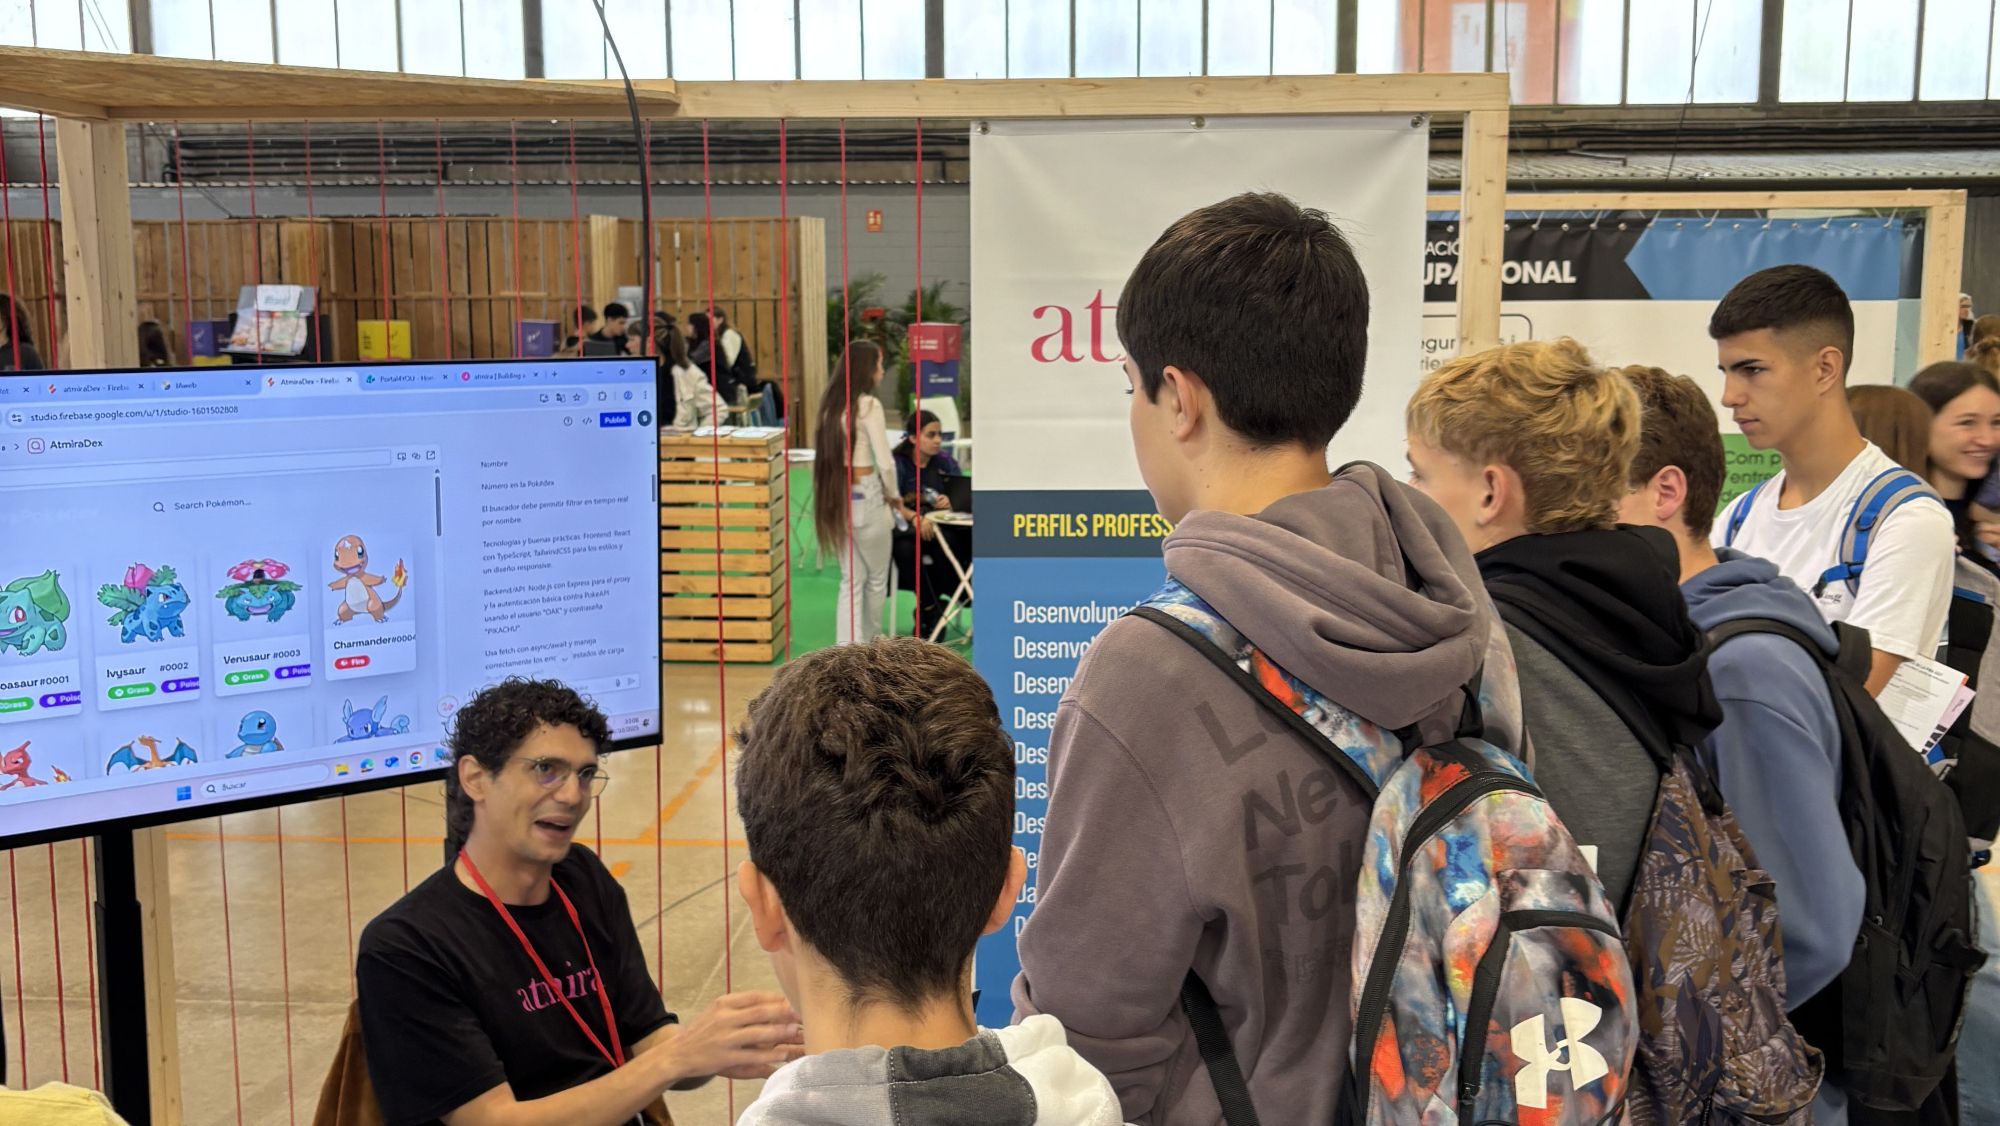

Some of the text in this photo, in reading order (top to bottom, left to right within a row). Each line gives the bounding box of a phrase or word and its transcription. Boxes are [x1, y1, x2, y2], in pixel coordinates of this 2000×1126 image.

[1031, 289, 1126, 363] at
[604, 416, 627, 424] Publish
[50, 438, 103, 450] AtmiraDex
[481, 460, 508, 469] Nombre
[481, 481, 508, 491] Número
[520, 480, 527, 488] la
[174, 501, 204, 511] Search
[482, 504, 488, 513] El
[489, 502, 520, 513] buscador
[521, 502, 538, 511] debe
[566, 498, 583, 507] filtrar
[594, 497, 616, 507] tiempo
[617, 495, 629, 504] real
[482, 519, 494, 528] por
[1013, 513, 1088, 538] PERFILS
[528, 536, 551, 545] buenas
[614, 529, 631, 537] React
[572, 546, 587, 555] para
[588, 544, 597, 552] los
[598, 543, 618, 551] estilos
[483, 567, 492, 575] un
[494, 564, 516, 573] diseño
[554, 582, 566, 590] con
[567, 579, 590, 589] Express
[591, 578, 606, 588] para
[606, 576, 613, 584] el
[613, 575, 631, 585] proxy
[484, 602, 488, 611] y
[489, 600, 496, 609] la
[497, 596, 541, 608] autenticación
[542, 594, 562, 604] básica
[563, 592, 583, 602] contra
[484, 612, 509, 623] usando
[510, 611, 516, 620] el
[517, 609, 542, 620] usuario
[564, 608, 568, 617] y
[569, 602, 603, 614] contraseña
[1013, 600, 1141, 624] Desenvolupa
[485, 638, 597, 658] Usa fetch con async/await y maneja
[1014, 635, 1096, 659] Desenvo
[223, 649, 301, 665] Venusaur #0003
[351, 658, 366, 667] Fire
[485, 657, 532, 670] correctamente
[533, 656, 543, 665] los
[608, 647, 625, 657] carga
[106, 662, 189, 679] Ivysaur #0002
[242, 673, 264, 681] Grass
[40, 675, 70, 686] #0001
[1014, 671, 1074, 695] Desen
[127, 686, 150, 695] Grass
[221, 782, 246, 793] Buscar
